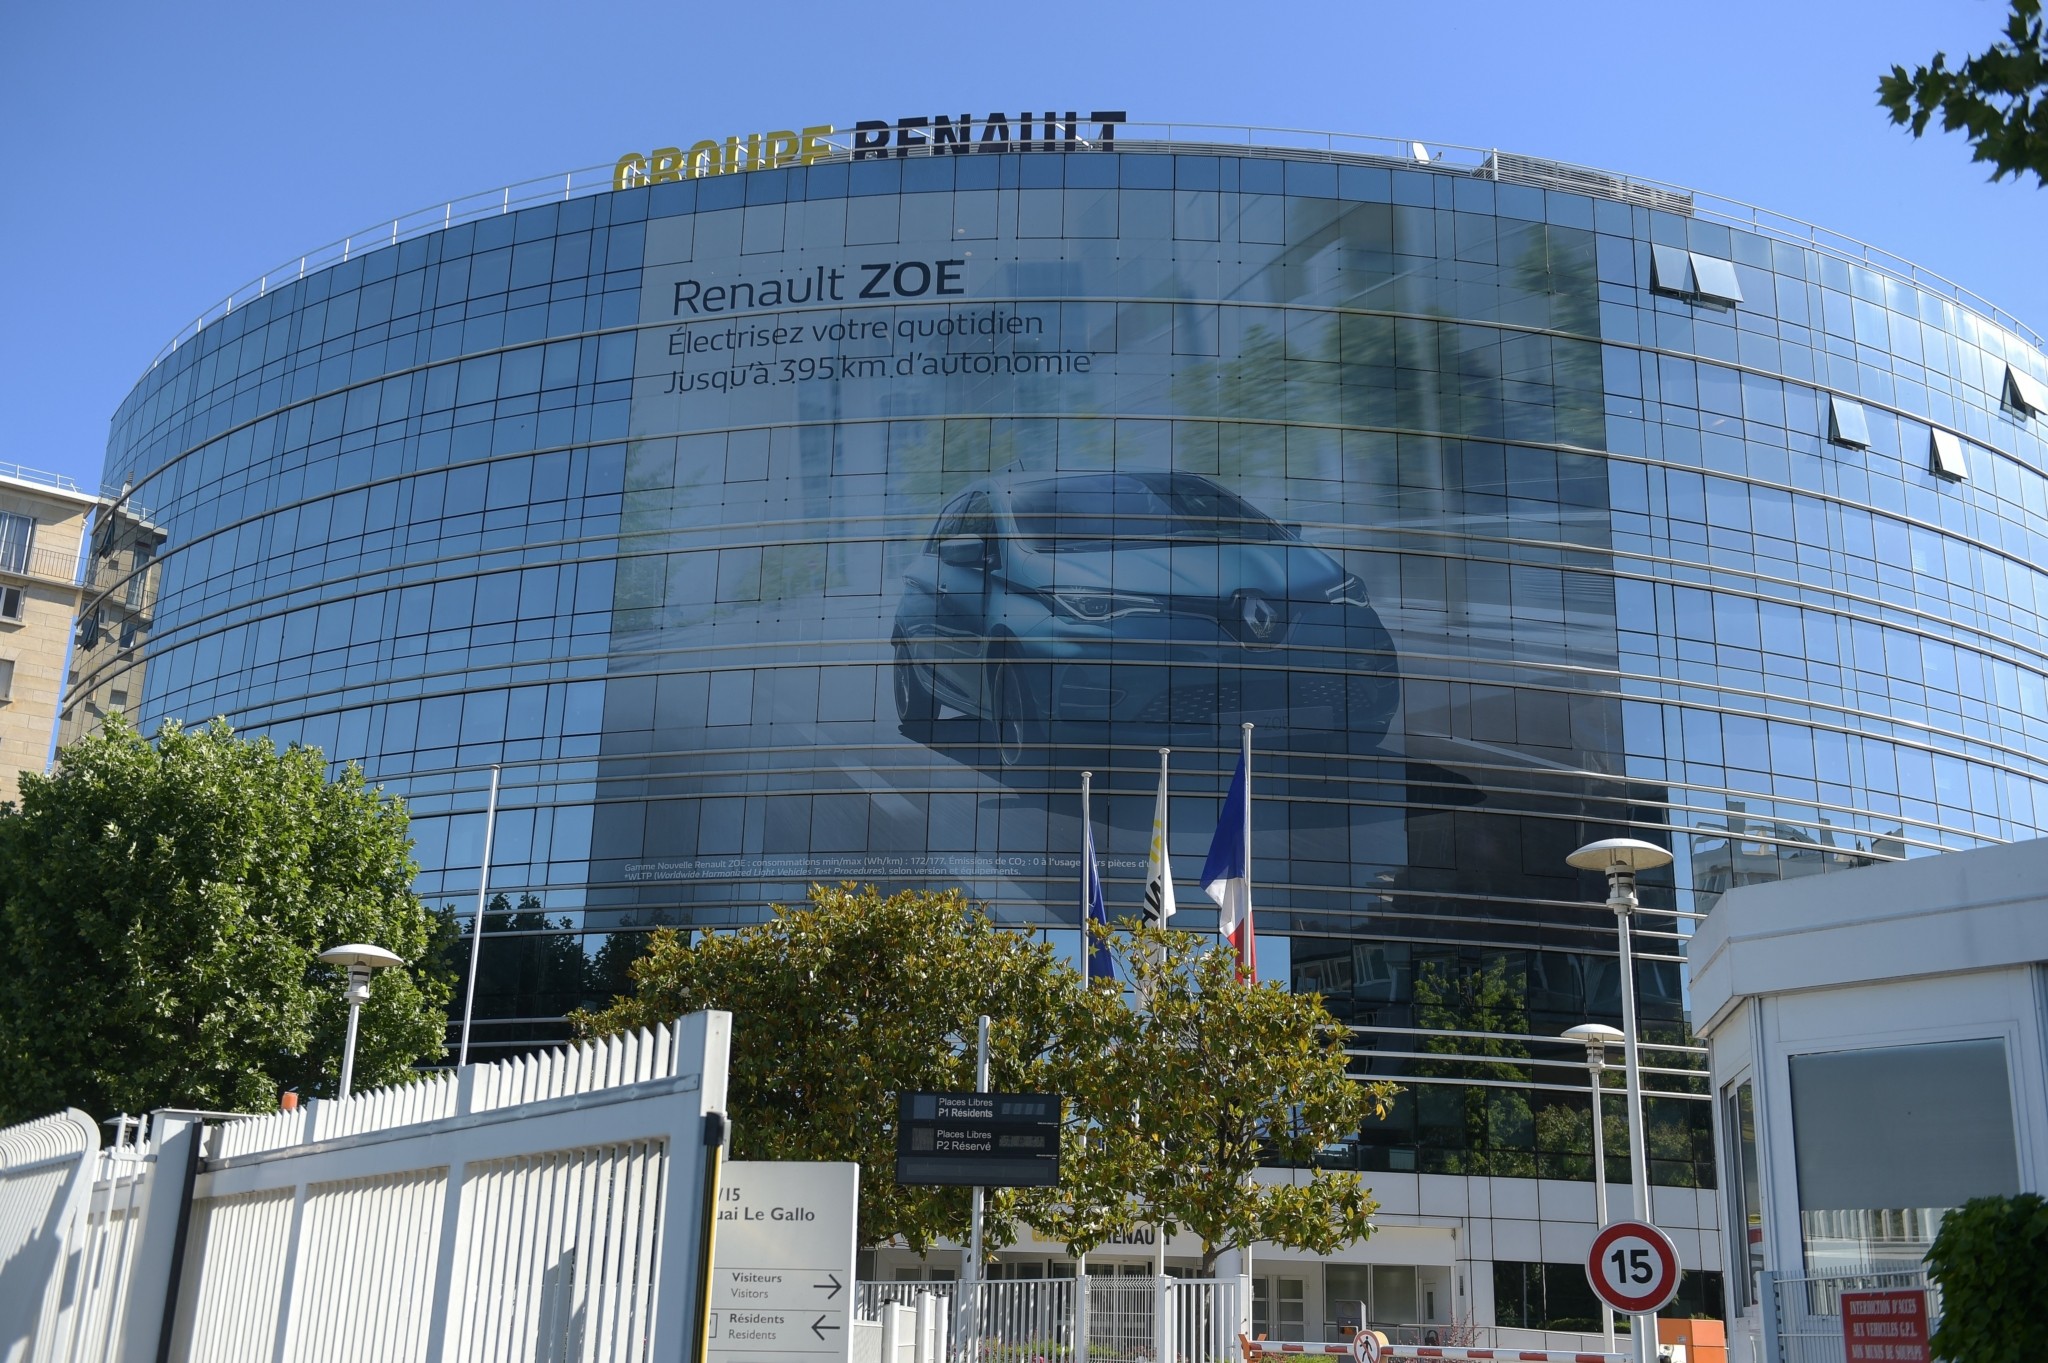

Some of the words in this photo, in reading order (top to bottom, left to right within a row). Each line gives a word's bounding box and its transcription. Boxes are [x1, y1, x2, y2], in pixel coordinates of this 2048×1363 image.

[613, 124, 834, 191] GROUPE
[854, 111, 1126, 160] RENAULT
[673, 265, 845, 315] Renault
[859, 260, 965, 299] ZOE
[668, 325, 803, 355] Électrisez
[812, 318, 888, 341] votre
[897, 310, 1043, 343] quotidien
[664, 361, 769, 393] Jusqu'à
[778, 356, 834, 383] 395
[842, 355, 885, 379] km
[624, 862, 656, 872] Gamme
[657, 860, 693, 870] Nouvelle
[695, 860, 727, 869] Renault
[728, 859, 746, 868] ZOE
[752, 857, 821, 868] consommations
[822, 856, 862, 866] min/max
[864, 856, 903, 867] (Wh/km)
[949, 855, 993, 865] Émissions
[995, 857, 1007, 865] de
[1041, 857, 1047, 866] à
[1049, 857, 1081, 869] l'usage
[1107, 859, 1137, 869] pièces
[654, 870, 700, 880] (Worldwide
[701, 868, 752, 879] Harmonized
[754, 867, 775, 878] Light
[777, 867, 812, 876] Vehicles
[814, 867, 831, 876] Test
[888, 867, 913, 875] selon
[914, 867, 947, 876] version
[949, 867, 959, 876] et
[961, 866, 1021, 877] équipements.
[938, 1097, 966, 1107] Places
[968, 1098, 993, 1107] Libres
[938, 1108, 949, 1118] P1
[951, 1107, 993, 1118] Résidents
[937, 1129, 965, 1139] Places
[966, 1130, 992, 1140] Libres
[936, 1141, 950, 1151] P2
[951, 1140, 991, 1151] Réservé
[717, 1206, 738, 1221] uai
[744, 1206, 765, 1221] Le
[770, 1206, 815, 1222] Gallo
[1611, 1249, 1653, 1284] 15
[732, 1272, 782, 1283] Visiteurs
[731, 1288, 769, 1299] Visitors
[729, 1312, 785, 1324] Résidents
[728, 1329, 777, 1340] Residents
